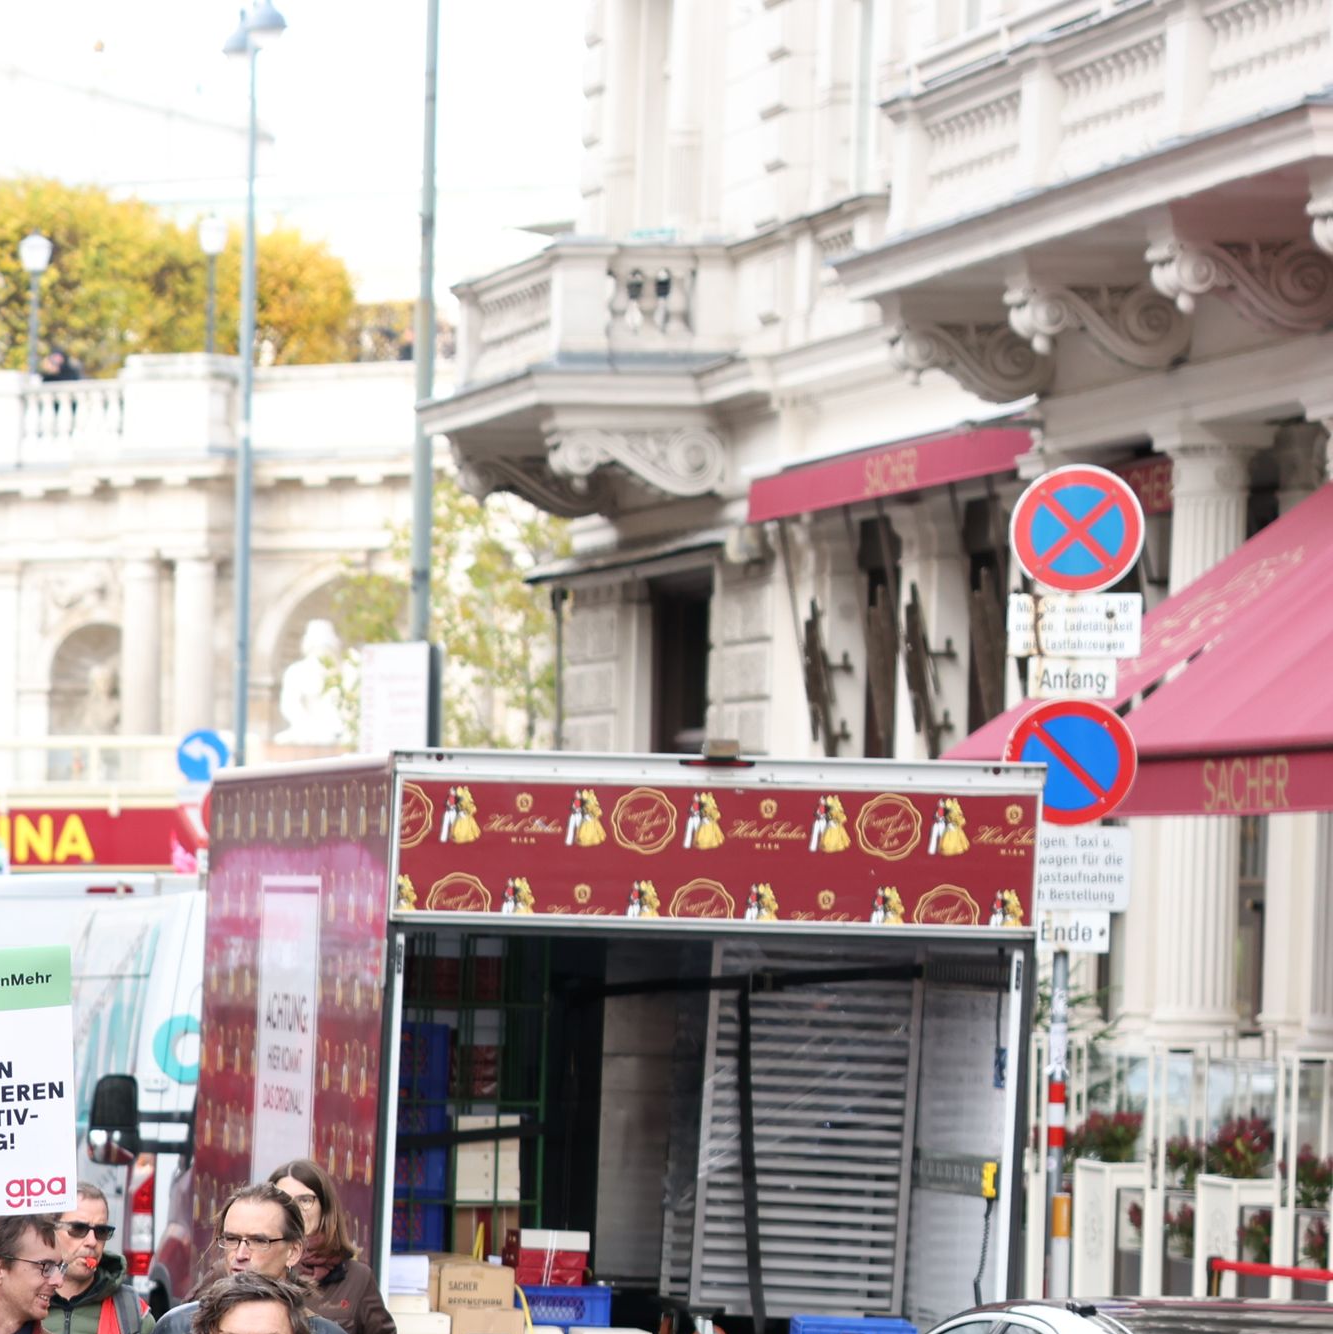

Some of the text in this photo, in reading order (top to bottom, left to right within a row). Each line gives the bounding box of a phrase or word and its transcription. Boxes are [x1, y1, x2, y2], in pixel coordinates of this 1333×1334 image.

[1040, 666, 1107, 694] Anfang
[1203, 756, 1290, 810] SACHER
[484, 813, 524, 833] Hotel
[728, 818, 763, 839] Hotel
[973, 825, 1007, 845] Hotel
[1075, 835, 1099, 848] Taxi
[1082, 853, 1099, 865] für
[1104, 853, 1124, 865] die
[1050, 889, 1115, 902] Bestellung
[1040, 920, 1093, 942] Ende
[5, 1176, 67, 1208] gpa
[448, 1281, 478, 1292] SACHER
